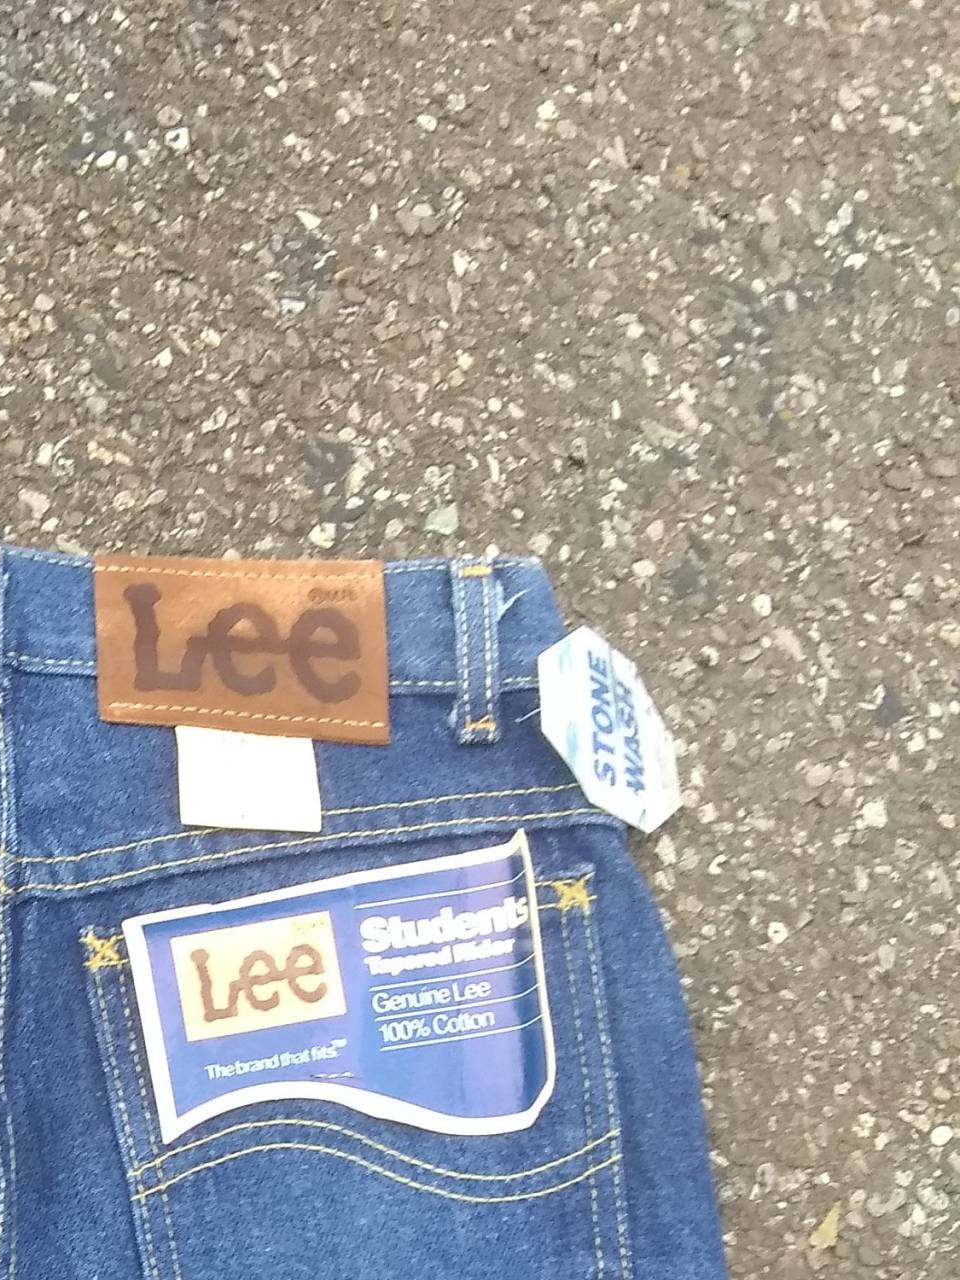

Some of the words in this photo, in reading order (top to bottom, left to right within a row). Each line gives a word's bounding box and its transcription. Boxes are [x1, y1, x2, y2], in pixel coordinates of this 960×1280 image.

[123, 582, 361, 704] Lee
[587, 650, 617, 787] STONE
[614, 680, 646, 796] WASH
[190, 943, 328, 1022] Lee
[372, 986, 451, 1013] Genuine
[452, 981, 491, 1002] Lee
[204, 1063, 236, 1080] The
[235, 1054, 280, 1074] brand
[279, 1048, 311, 1067] that
[379, 1017, 432, 1043] 100%
[432, 1011, 496, 1036] Cotton
